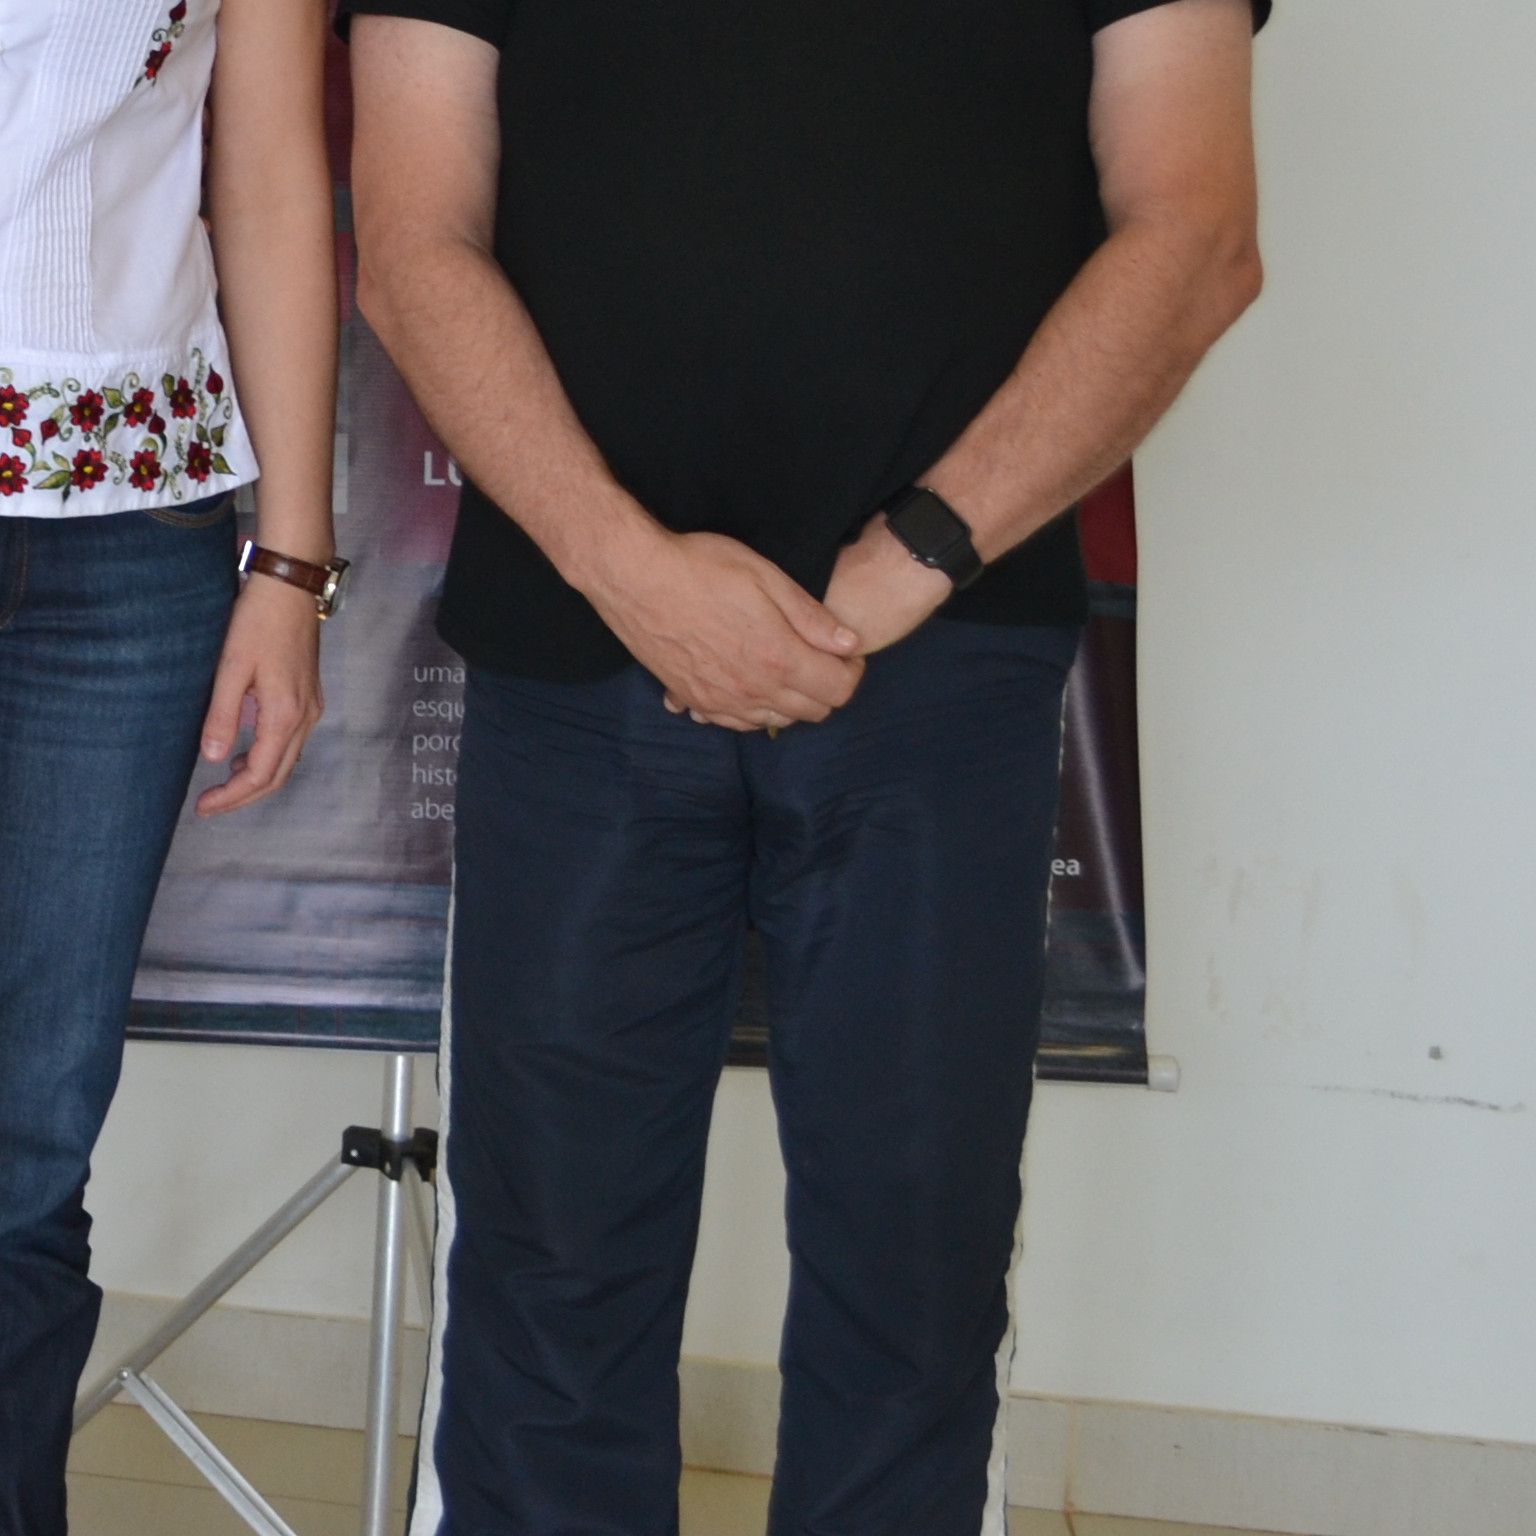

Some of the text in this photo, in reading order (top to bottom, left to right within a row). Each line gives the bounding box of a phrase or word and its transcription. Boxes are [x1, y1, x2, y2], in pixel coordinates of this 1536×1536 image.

[414, 666, 466, 684] uma
[412, 761, 457, 786] hist
[1050, 858, 1081, 876] ea
